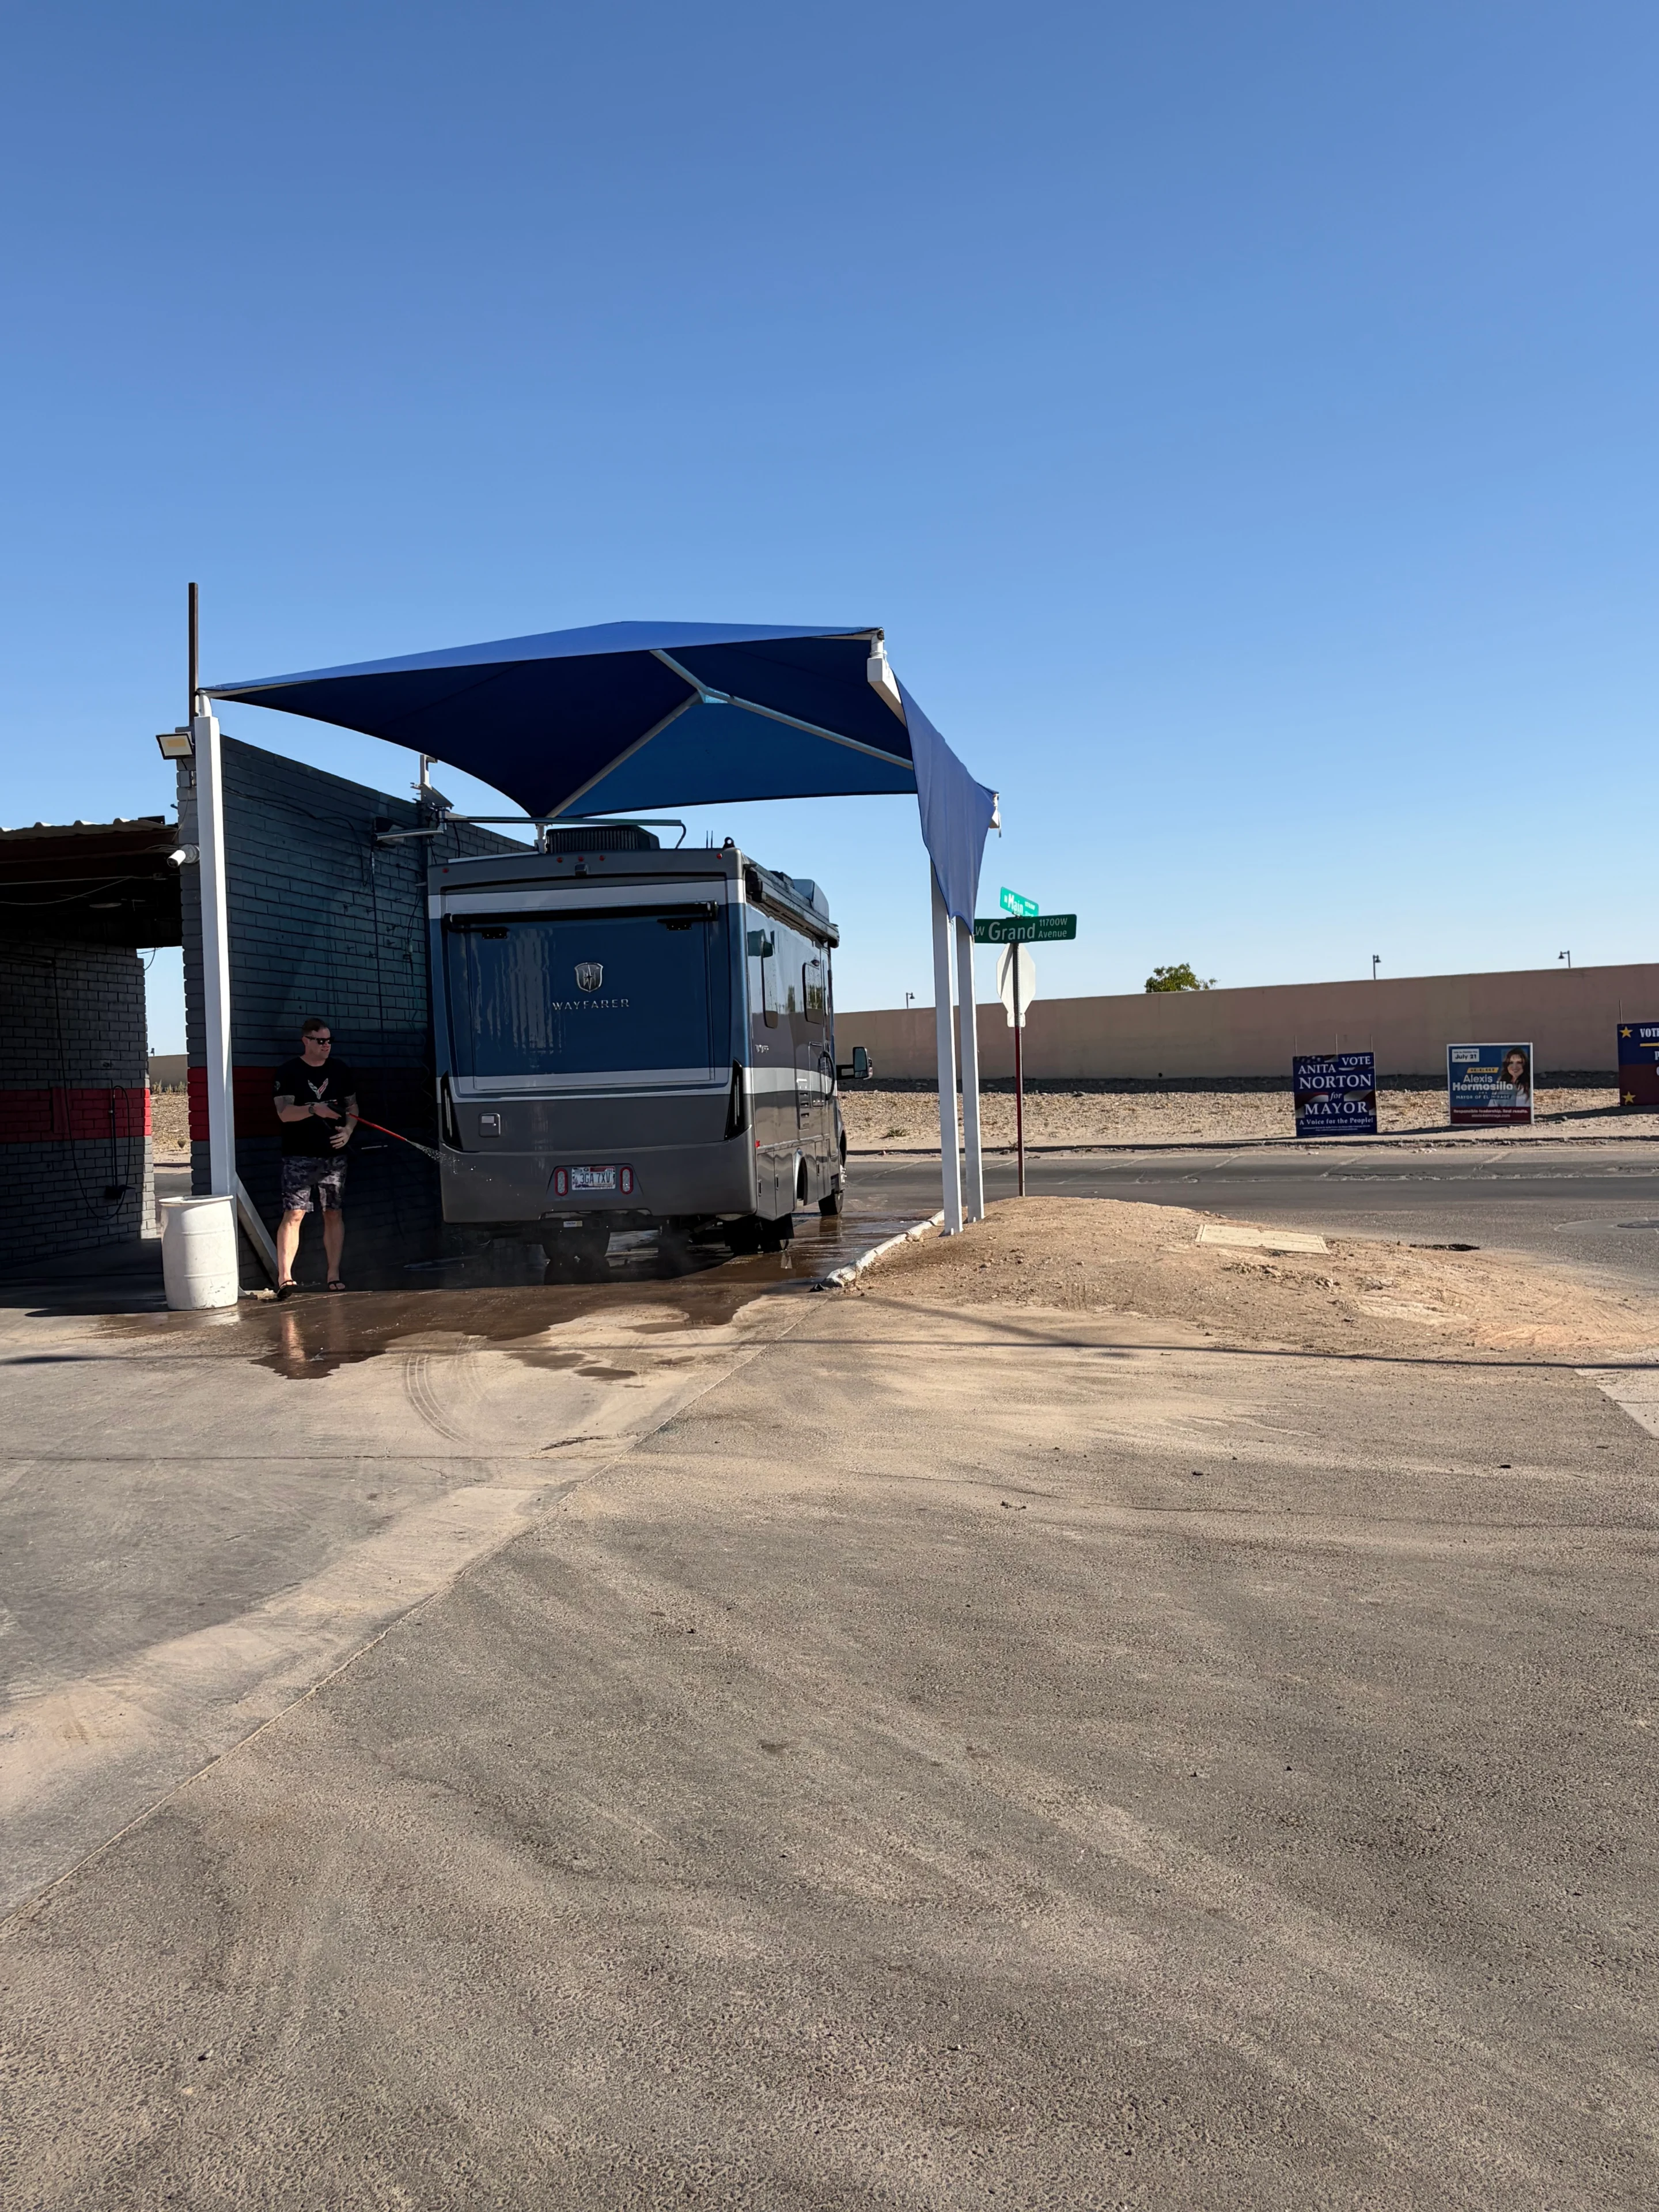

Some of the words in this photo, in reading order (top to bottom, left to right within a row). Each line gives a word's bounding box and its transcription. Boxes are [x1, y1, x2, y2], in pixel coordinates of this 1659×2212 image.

[1007, 893, 1023, 916] Main
[1039, 917, 1068, 927] 11700W
[975, 926, 985, 936] W
[988, 922, 1036, 941] Grand
[1037, 929, 1067, 939] Avenue
[552, 998, 630, 1010] WAYFARER
[1341, 1056, 1371, 1066] VOTE
[1298, 1064, 1336, 1074] ANITA
[1299, 1074, 1372, 1089] NORTON
[1463, 1074, 1493, 1083] Alexis
[1330, 1092, 1342, 1101] for
[1304, 1101, 1368, 1115] MAYOR
[1349, 1116, 1373, 1125] People!
